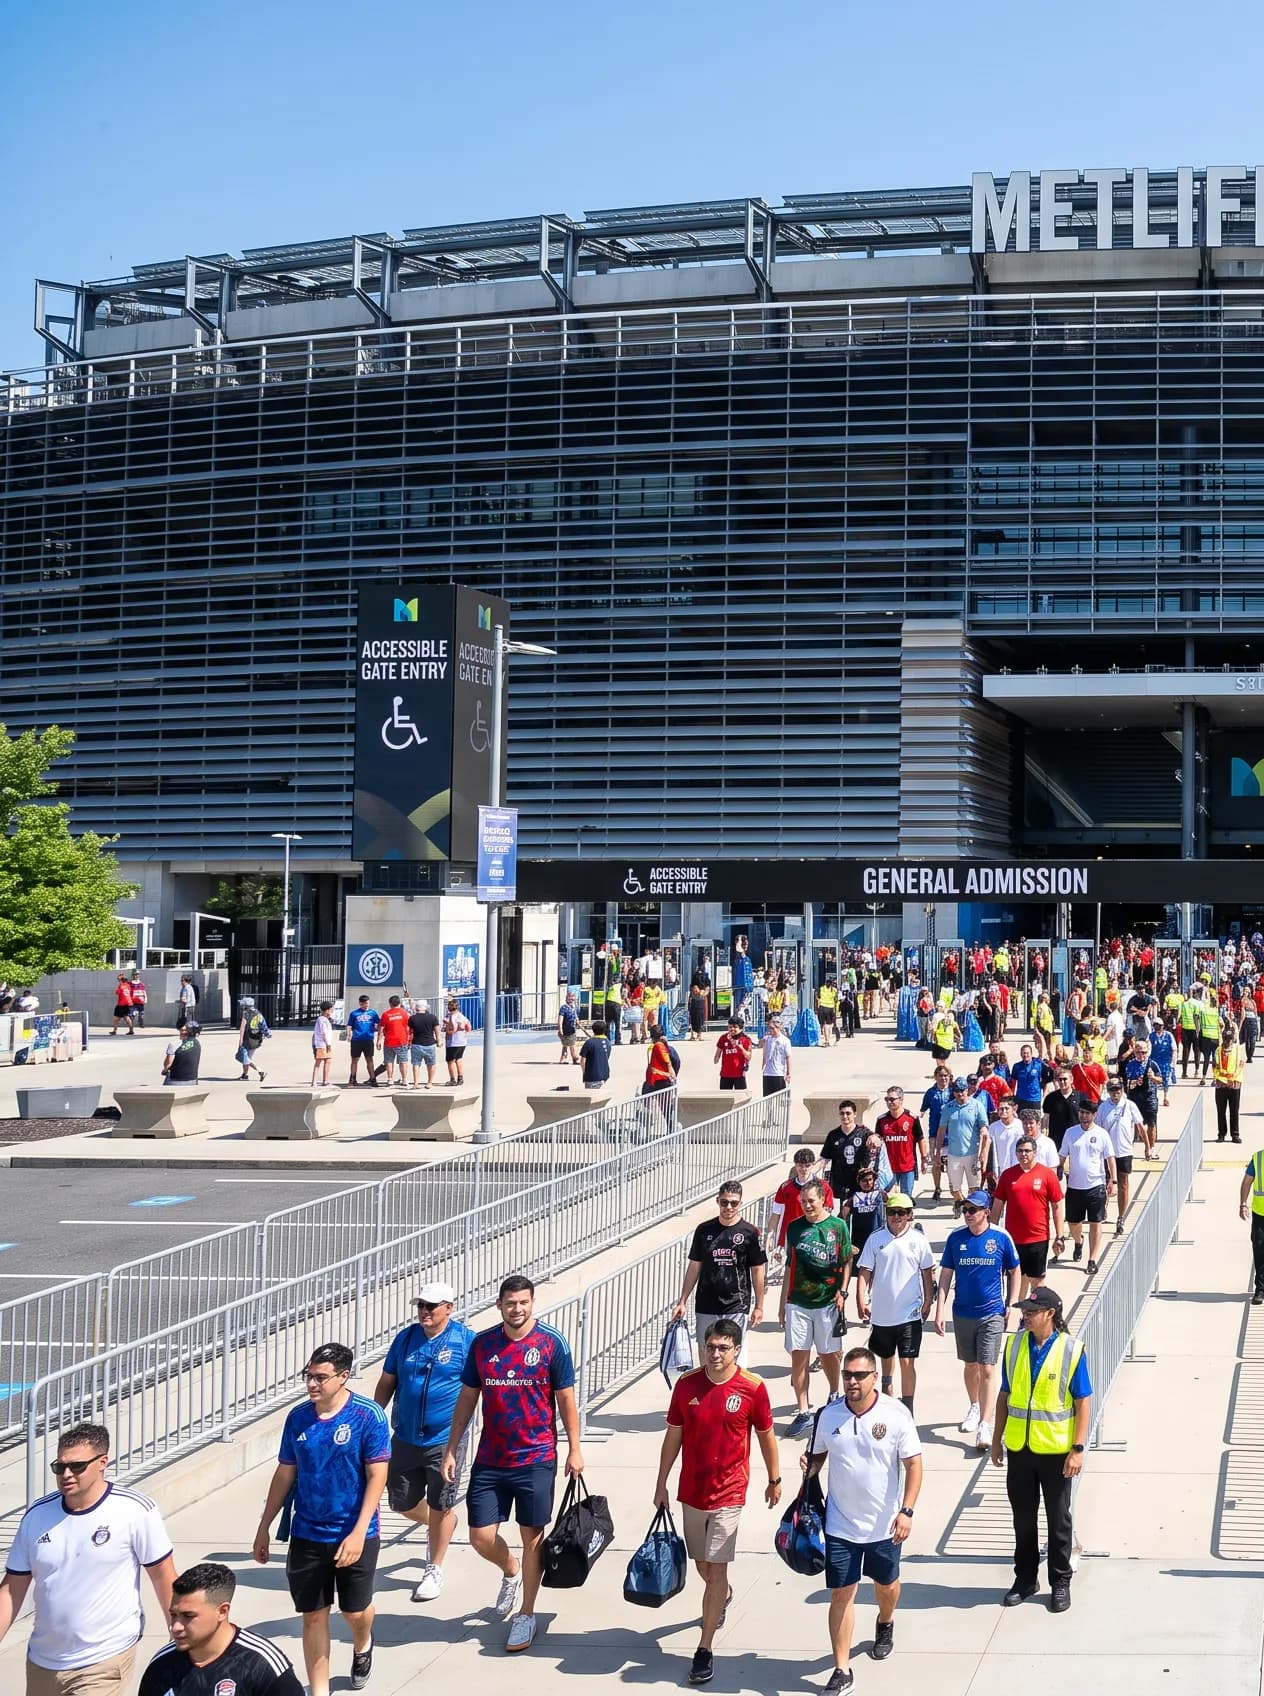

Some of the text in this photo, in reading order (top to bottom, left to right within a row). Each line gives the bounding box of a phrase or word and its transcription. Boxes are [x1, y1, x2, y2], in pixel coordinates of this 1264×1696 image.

[361, 640, 448, 659] ACCESSIBLE
[361, 661, 448, 680] GATE ENTRY
[649, 867, 708, 880] ACCESSIBLE
[863, 867, 1089, 895] GENERAL ADMISSION
[649, 881, 708, 895] GATE ENTRY
